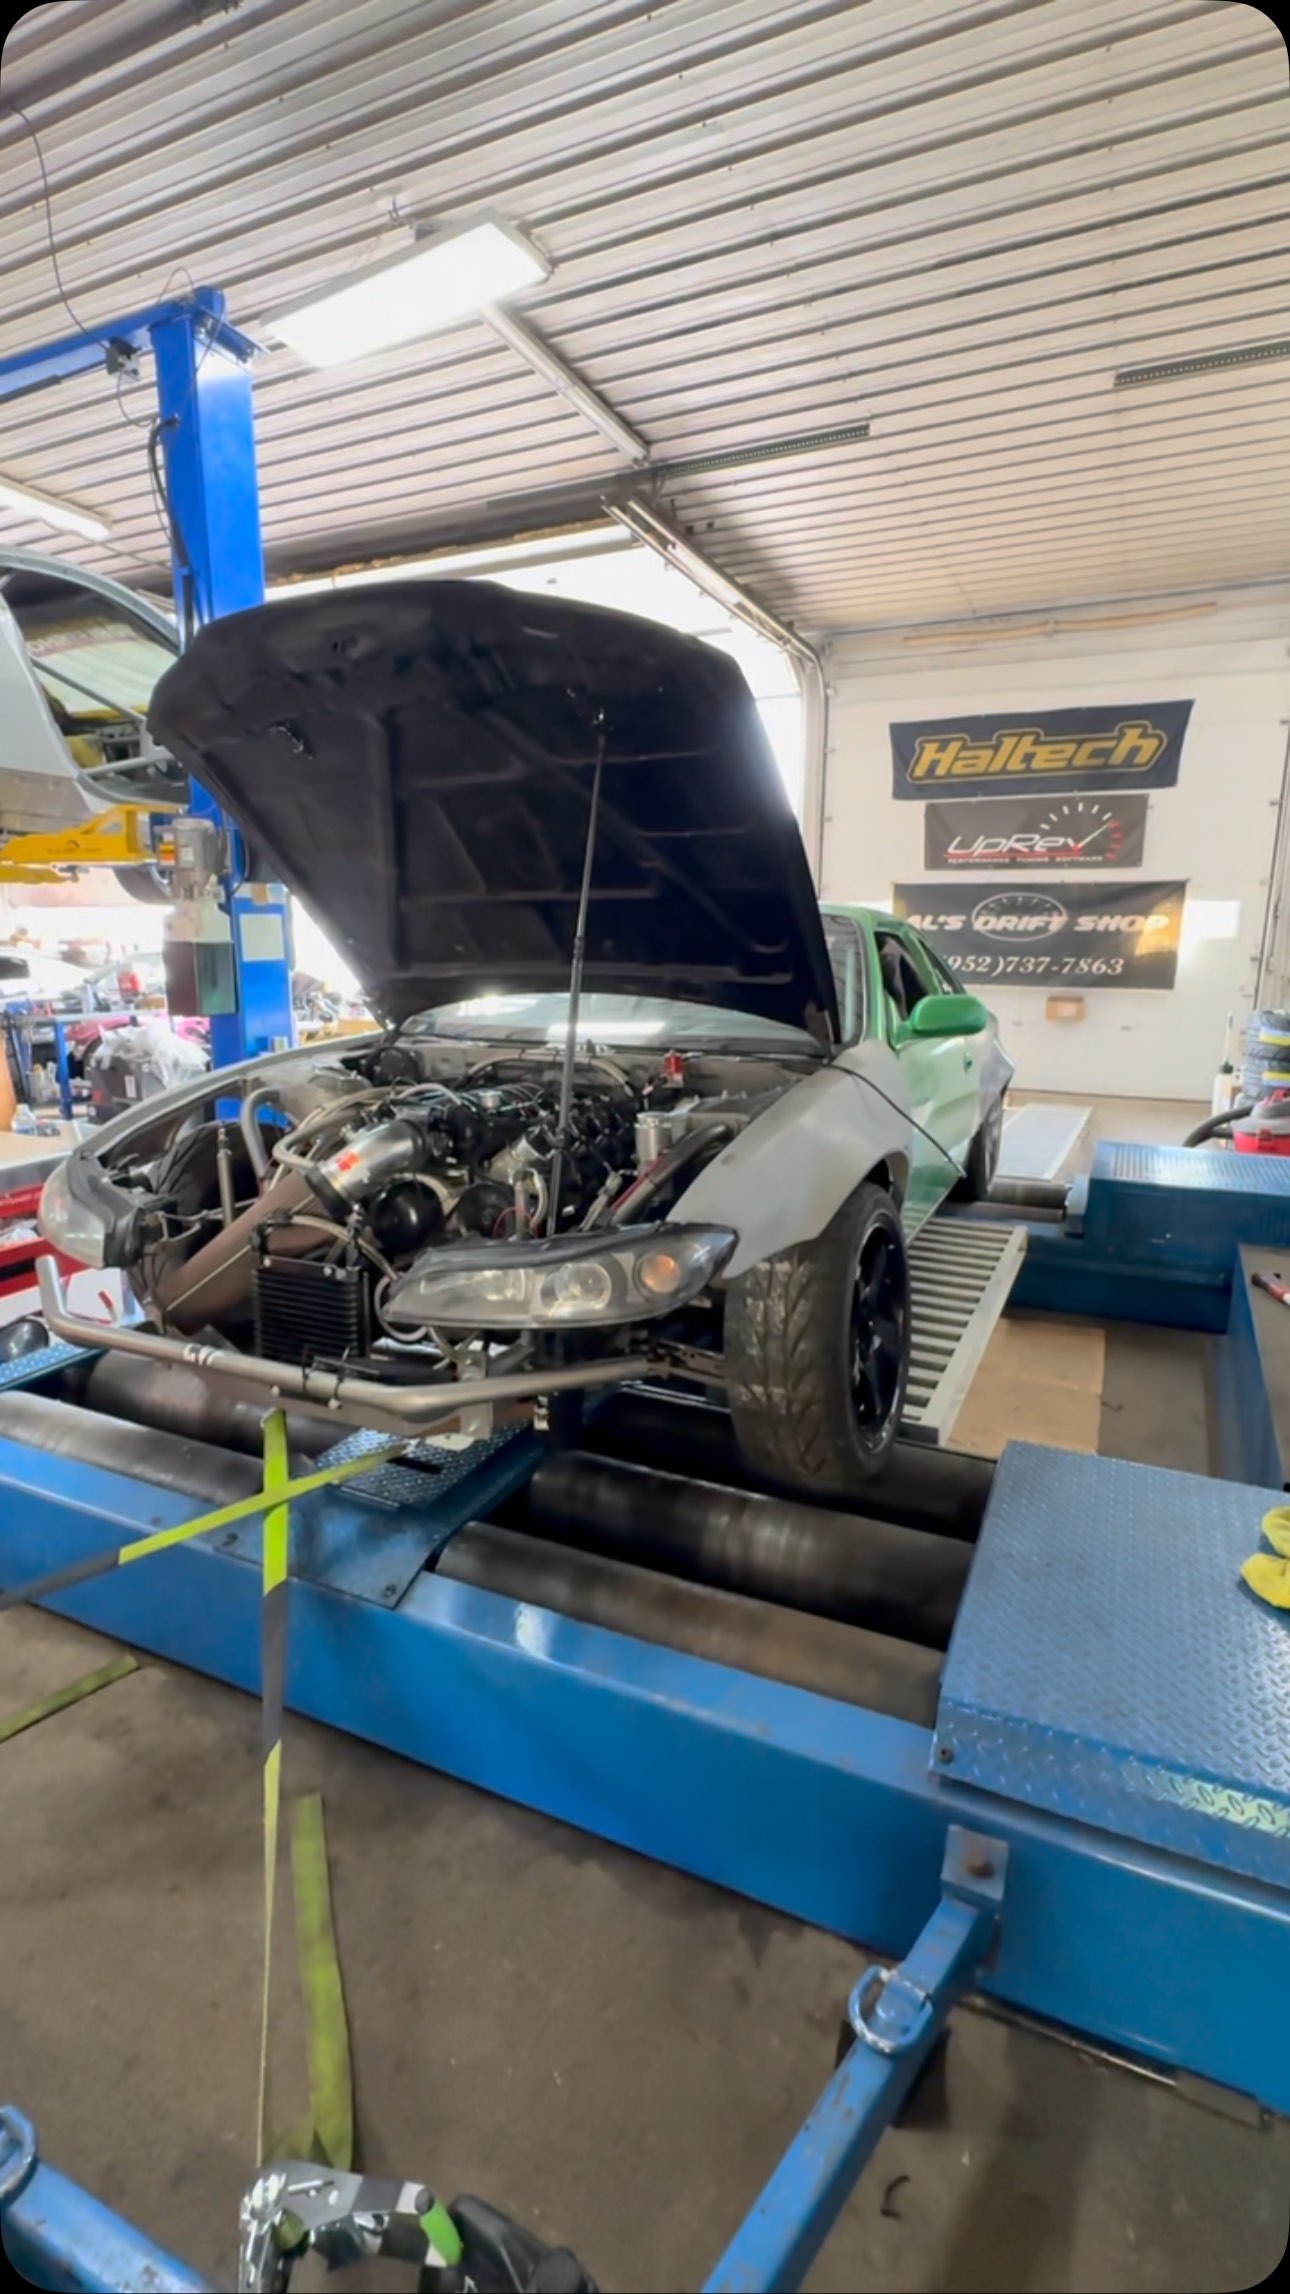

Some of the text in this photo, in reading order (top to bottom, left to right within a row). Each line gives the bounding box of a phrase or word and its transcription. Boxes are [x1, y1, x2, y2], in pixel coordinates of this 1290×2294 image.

[911, 726, 1162, 779] Haltech
[972, 915, 1067, 932] DRIFT
[1074, 915, 1169, 932] SHOP
[943, 955, 1124, 977] 952)737-7863
